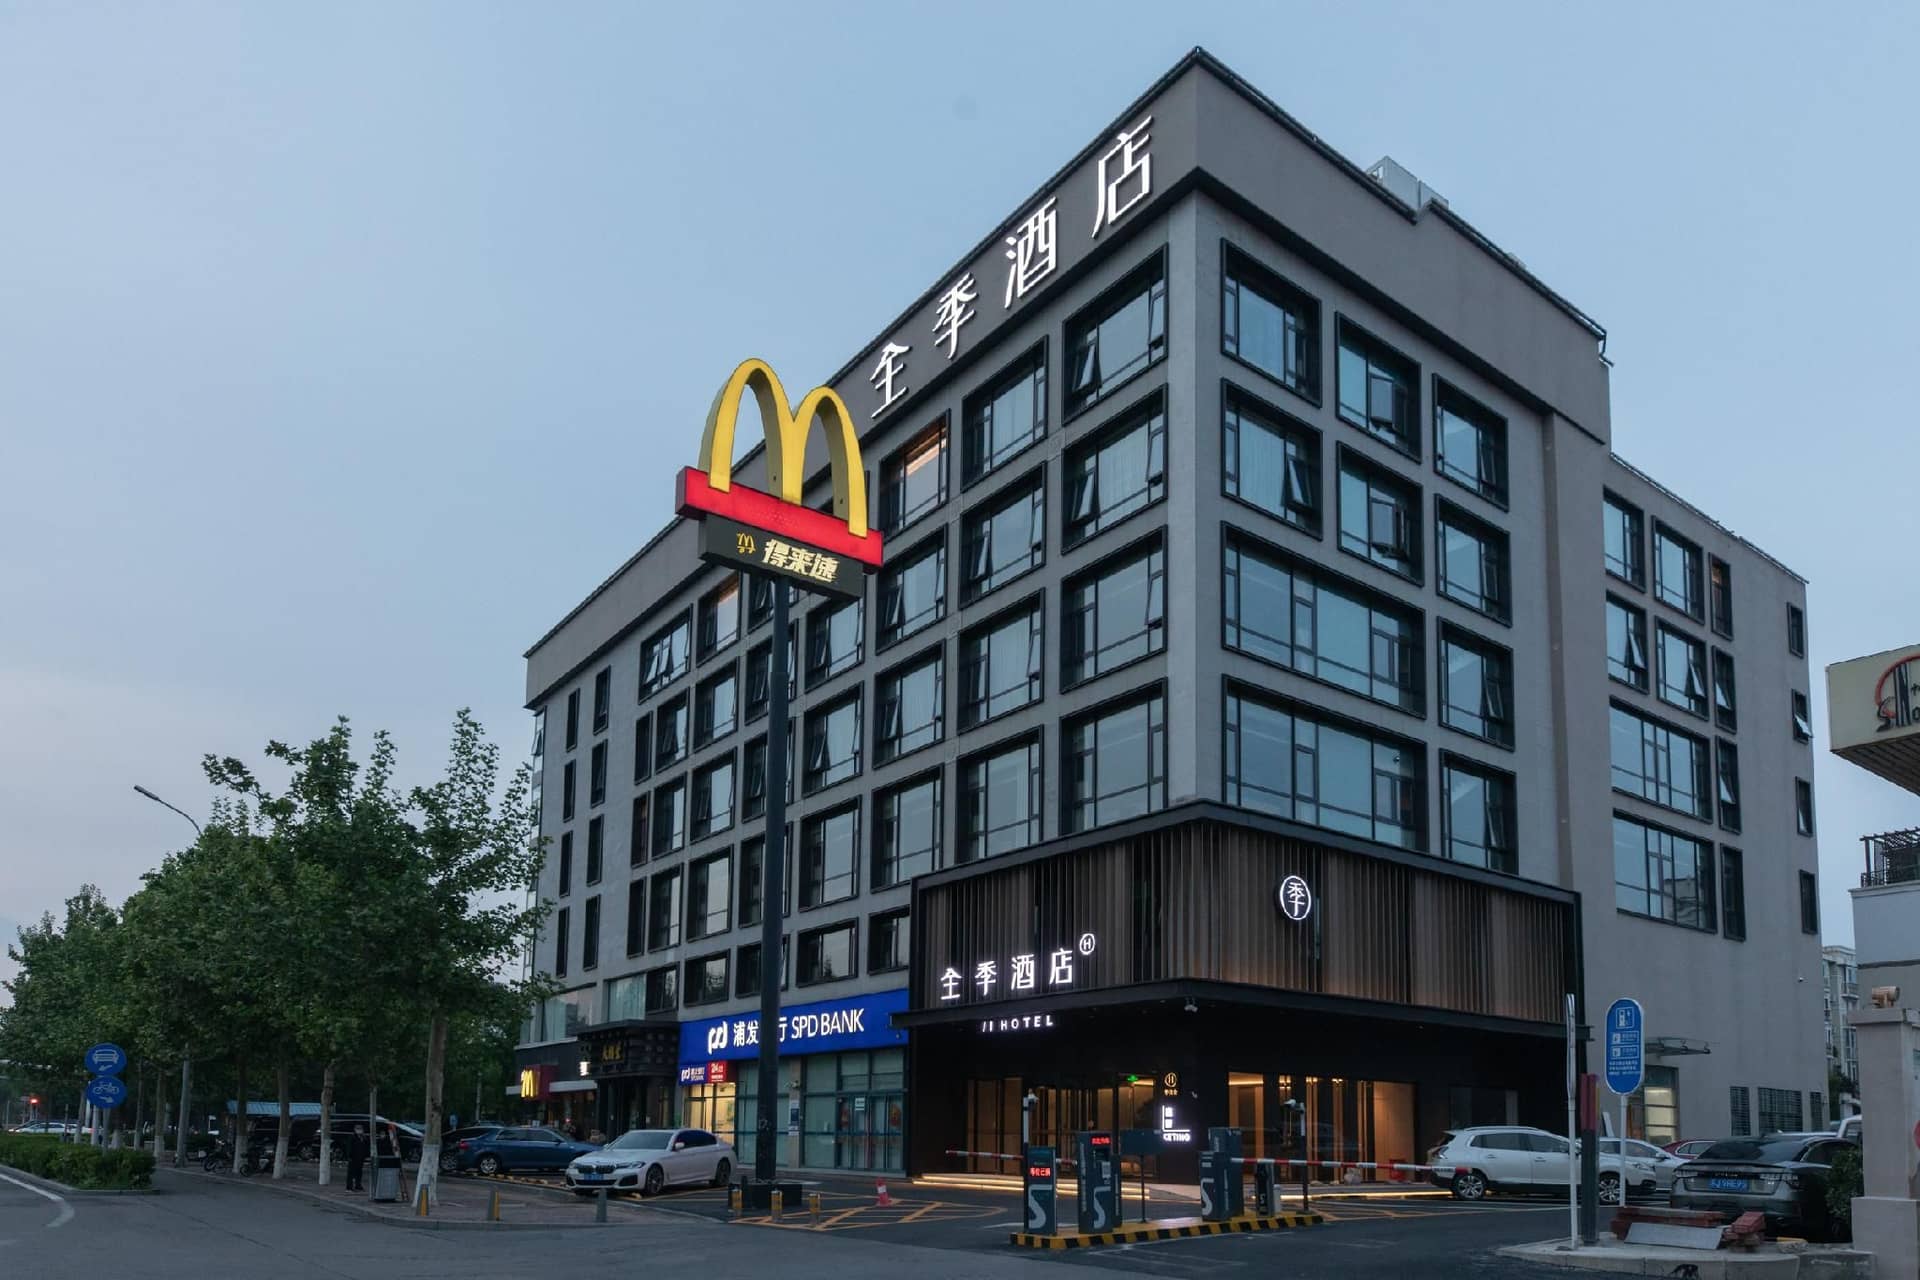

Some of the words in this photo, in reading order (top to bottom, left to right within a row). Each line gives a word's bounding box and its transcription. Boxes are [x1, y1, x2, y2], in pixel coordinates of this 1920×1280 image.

[870, 115, 1153, 419] 全季酒店
[1286, 880, 1306, 918] 季
[940, 947, 1074, 1001] 全季酒店
[733, 1017, 788, 1047] 浦发行
[791, 1015, 818, 1039] SPD
[820, 1007, 865, 1037] BANK
[1000, 1014, 1055, 1032] HOTEL
